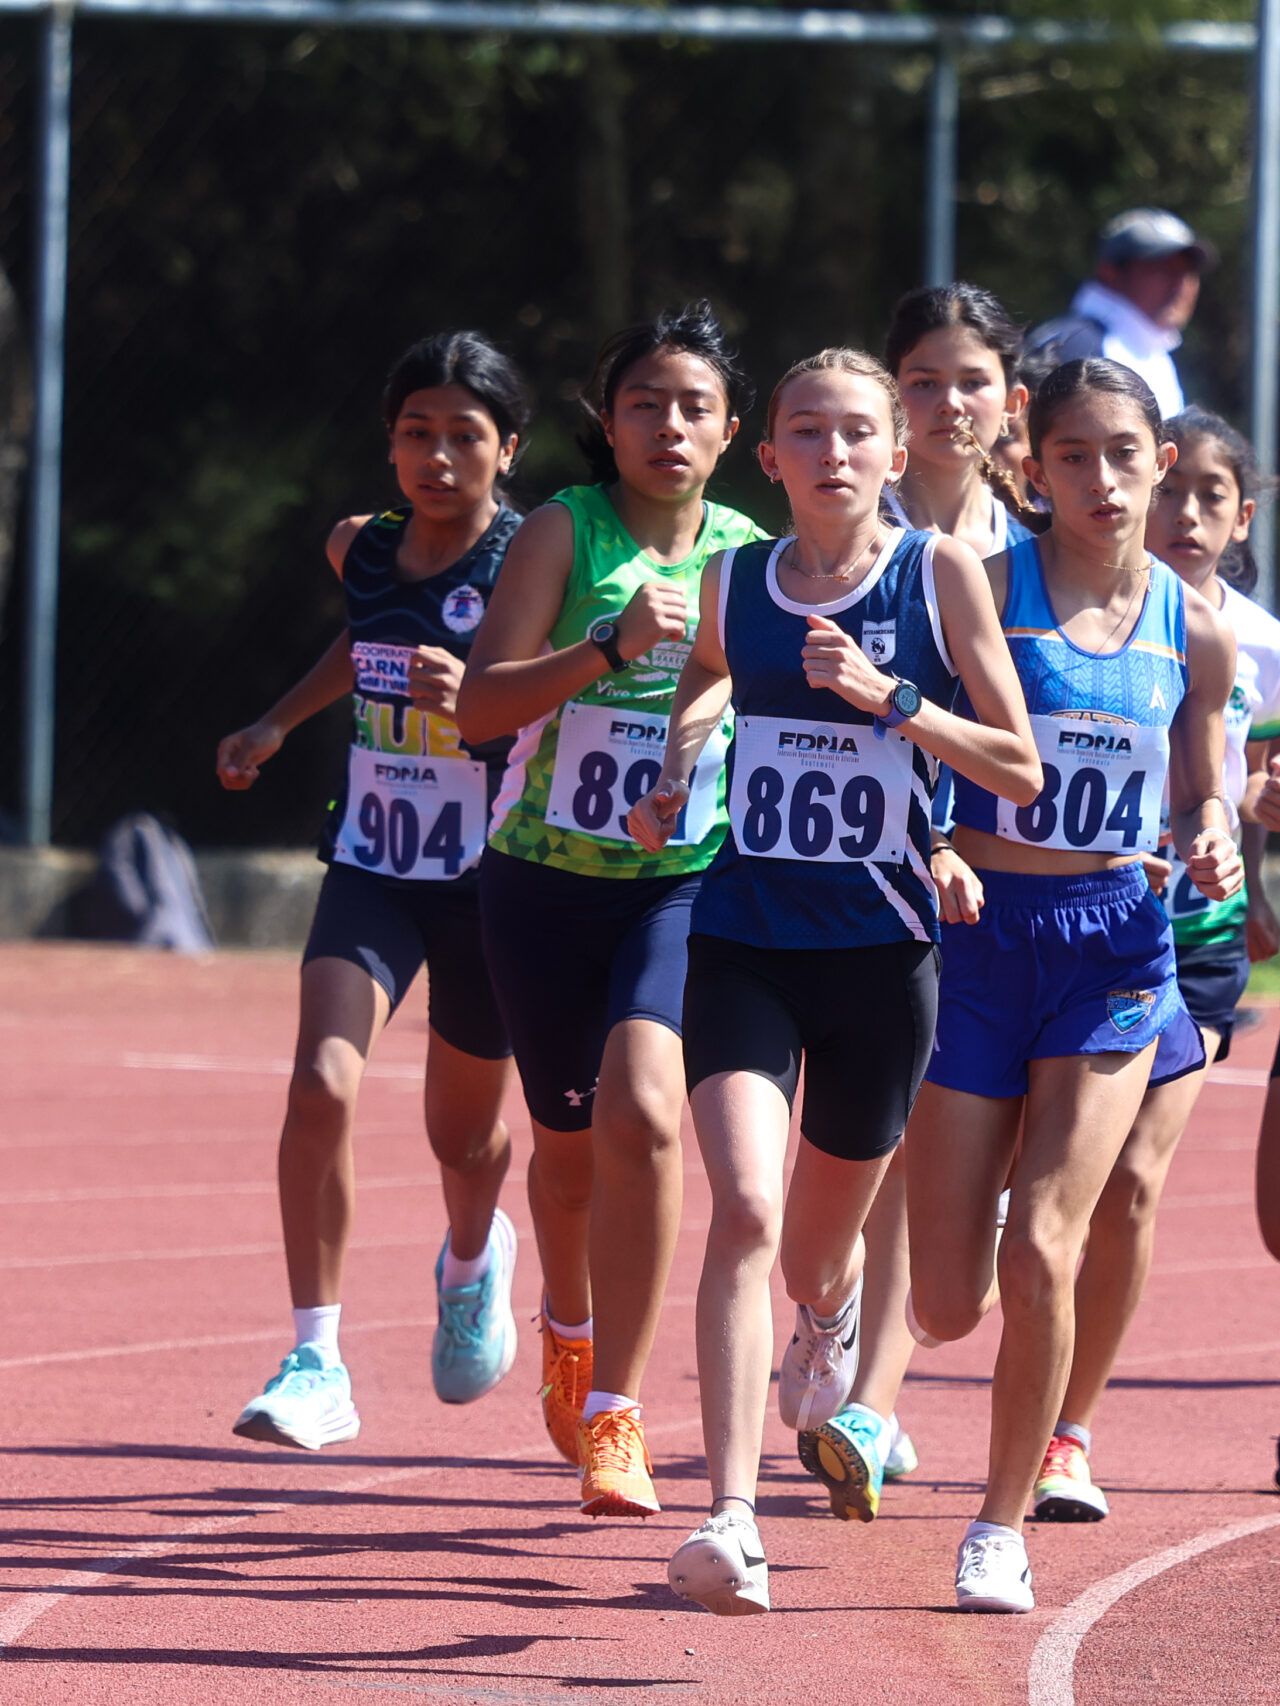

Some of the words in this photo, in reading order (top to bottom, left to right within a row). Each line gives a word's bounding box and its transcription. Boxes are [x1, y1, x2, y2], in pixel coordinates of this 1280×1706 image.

[778, 731, 859, 755] FDNA
[1059, 731, 1132, 754] FDNA
[375, 763, 437, 782] FDNA
[743, 766, 885, 858] 869
[1015, 762, 1146, 847] 804
[354, 792, 465, 876] 904
